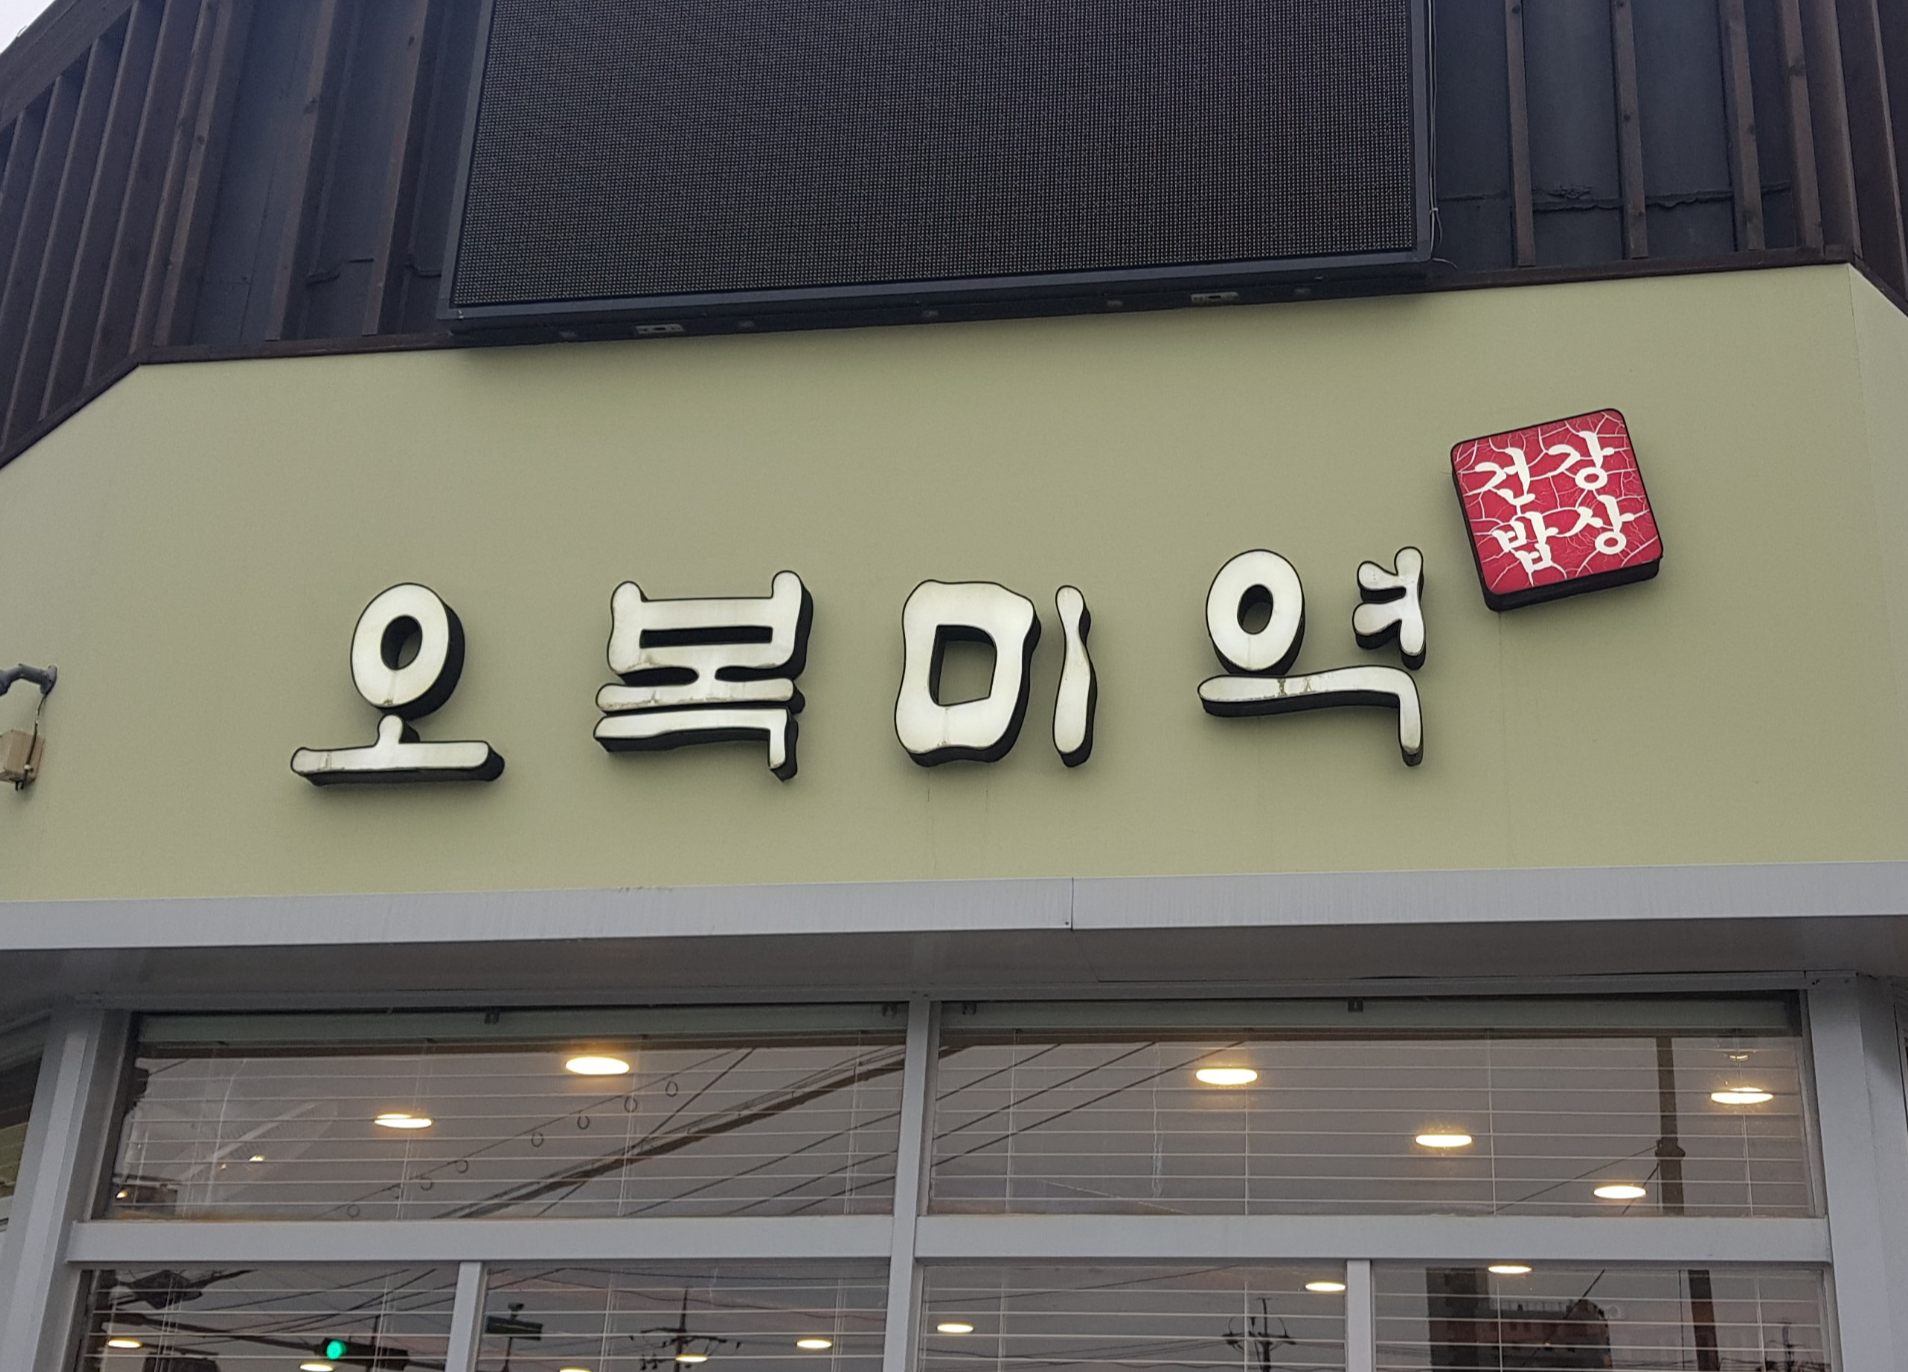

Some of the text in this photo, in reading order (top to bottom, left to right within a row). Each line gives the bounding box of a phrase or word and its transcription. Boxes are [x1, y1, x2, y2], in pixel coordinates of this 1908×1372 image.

[1463, 430, 1615, 506] 건강
[1492, 495, 1635, 574] 밥상
[291, 546, 1425, 775] 오복미역
